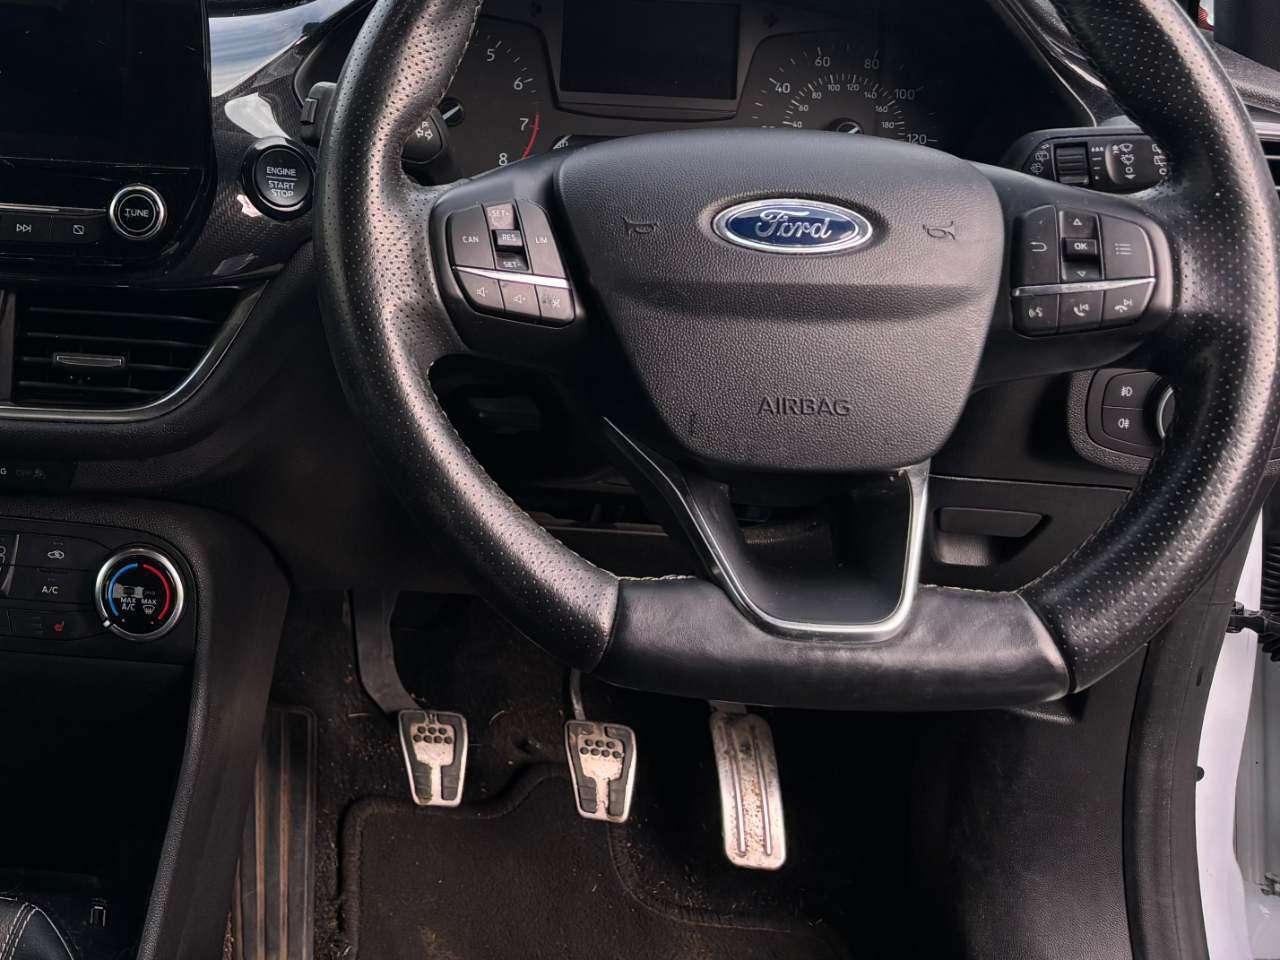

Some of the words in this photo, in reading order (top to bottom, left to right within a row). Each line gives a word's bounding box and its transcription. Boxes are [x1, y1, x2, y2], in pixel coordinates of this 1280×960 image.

[486, 48, 495, 62] 5
[815, 56, 831, 68] 60
[864, 58, 880, 70] 80
[513, 76, 523, 90] 6
[827, 83, 841, 91] 100
[846, 83, 860, 92] 120
[775, 82, 791, 94] 40
[811, 91, 822, 99] 80
[864, 91, 878, 99] 140
[895, 88, 916, 100] 100
[798, 104, 809, 112] 60
[875, 105, 889, 113] 160
[519, 117, 529, 131] 7
[792, 120, 803, 128] 40
[881, 120, 895, 129] 180
[906, 133, 927, 145] 120
[498, 152, 508, 166] 8
[266, 166, 297, 177] ENGINE
[268, 180, 295, 190] START
[271, 189, 294, 198] STOP
[125, 208, 149, 218] TUNE
[755, 209, 833, 239] Ford
[462, 235, 479, 244] CAN
[502, 233, 517, 242] RES
[1074, 241, 1088, 250] OK
[758, 396, 850, 417] AIRBAG
[41, 586, 59, 595] A/C
[121, 603, 136, 611] A/C
